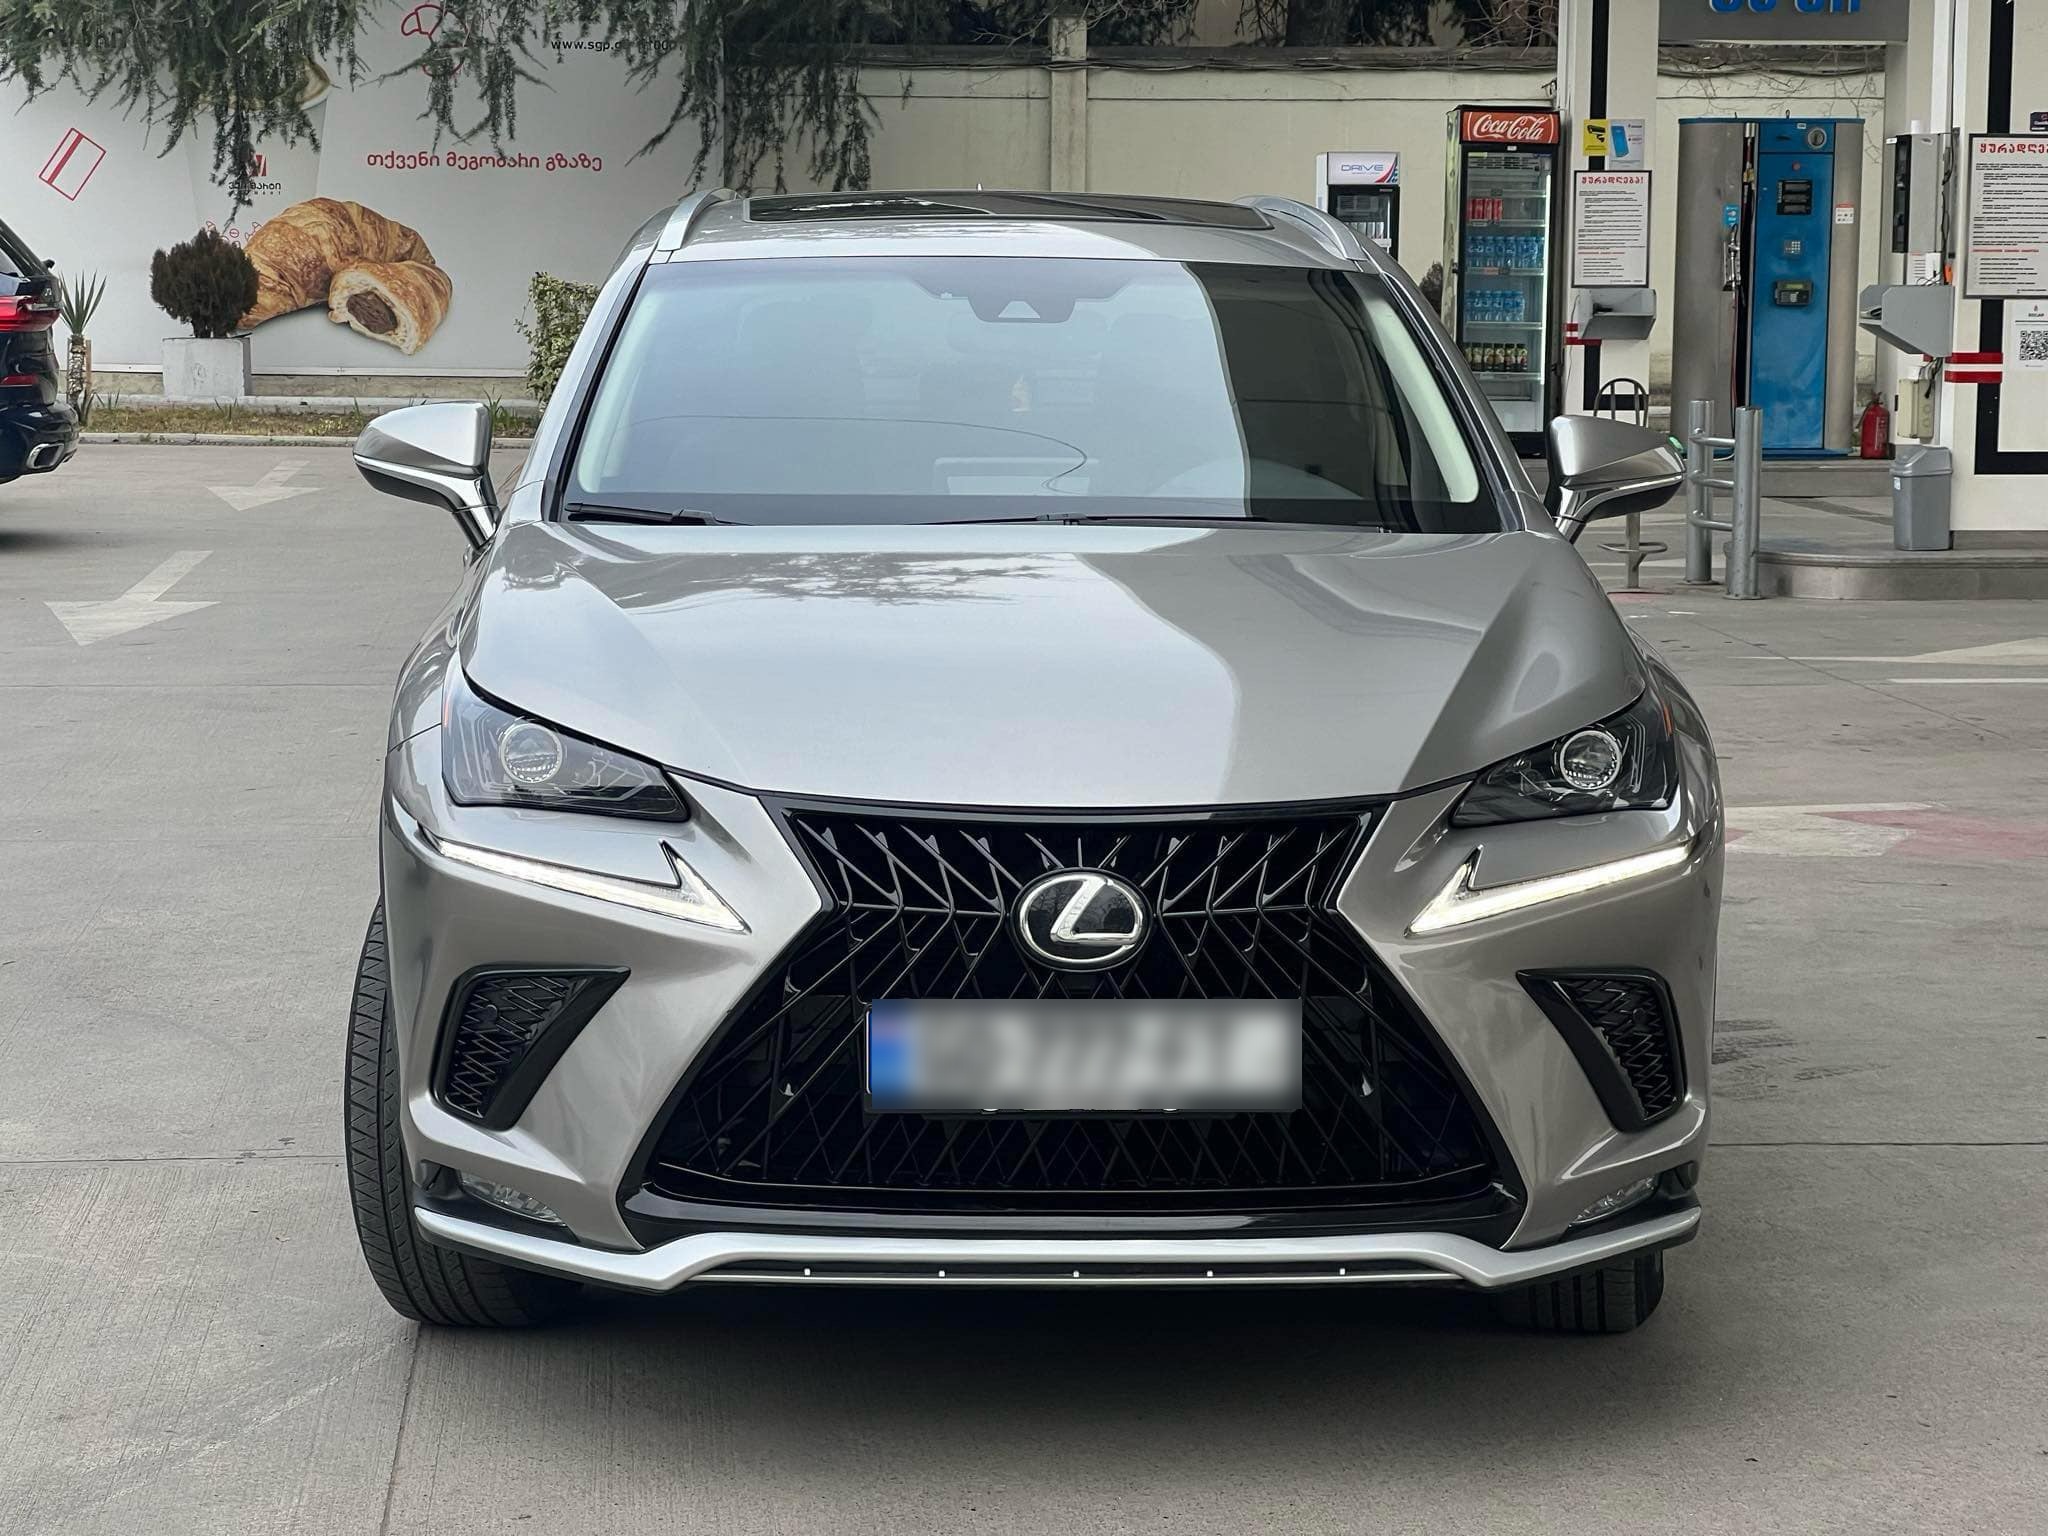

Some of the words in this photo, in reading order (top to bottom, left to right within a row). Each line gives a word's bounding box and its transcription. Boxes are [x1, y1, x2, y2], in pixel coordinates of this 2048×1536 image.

[1473, 114, 1547, 140] Coca-Cola
[1980, 143, 2048, 153] ყურადღე
[367, 151, 440, 169] თქვენი
[446, 151, 540, 170] მეგობარი
[545, 153, 603, 171] გზაზე
